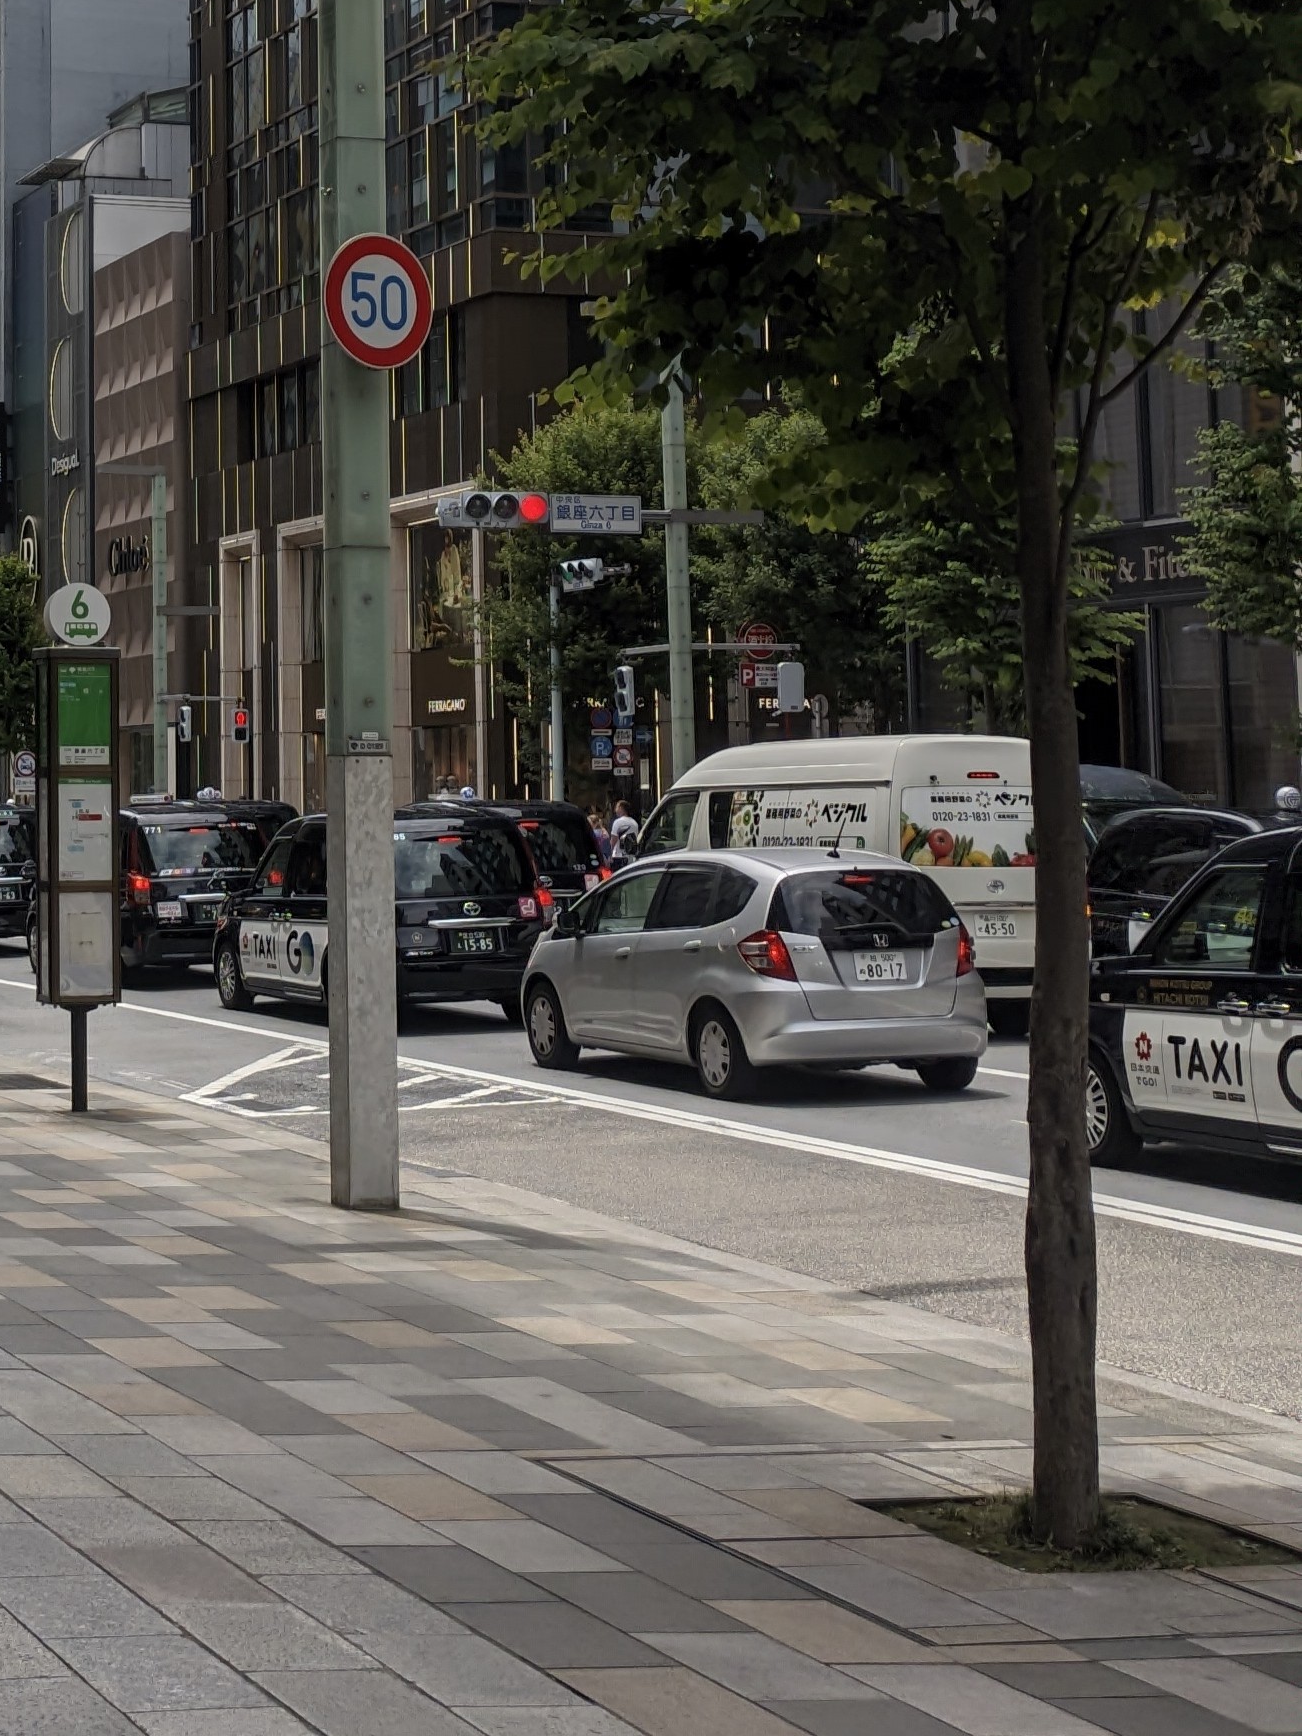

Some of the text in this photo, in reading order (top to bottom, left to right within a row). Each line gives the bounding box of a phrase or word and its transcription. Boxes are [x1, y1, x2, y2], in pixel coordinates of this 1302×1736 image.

[351, 271, 407, 330] 50
[557, 505, 635, 520] 銀座六丁目
[581, 520, 603, 530] Ginza
[1117, 556, 1137, 583] &
[1141, 546, 1201, 581] Fitc
[71, 589, 89, 619] 6
[742, 669, 754, 684] P
[428, 698, 467, 714] FERRAGAMO
[994, 792, 1033, 806] ベジク
[932, 811, 991, 822] 0120-23-1831
[985, 922, 1015, 935] 45-50
[253, 932, 276, 961] TAXI
[464, 938, 493, 951] 15-85
[867, 963, 903, 978] 80-17
[1167, 1034, 1243, 1088] TAXI
